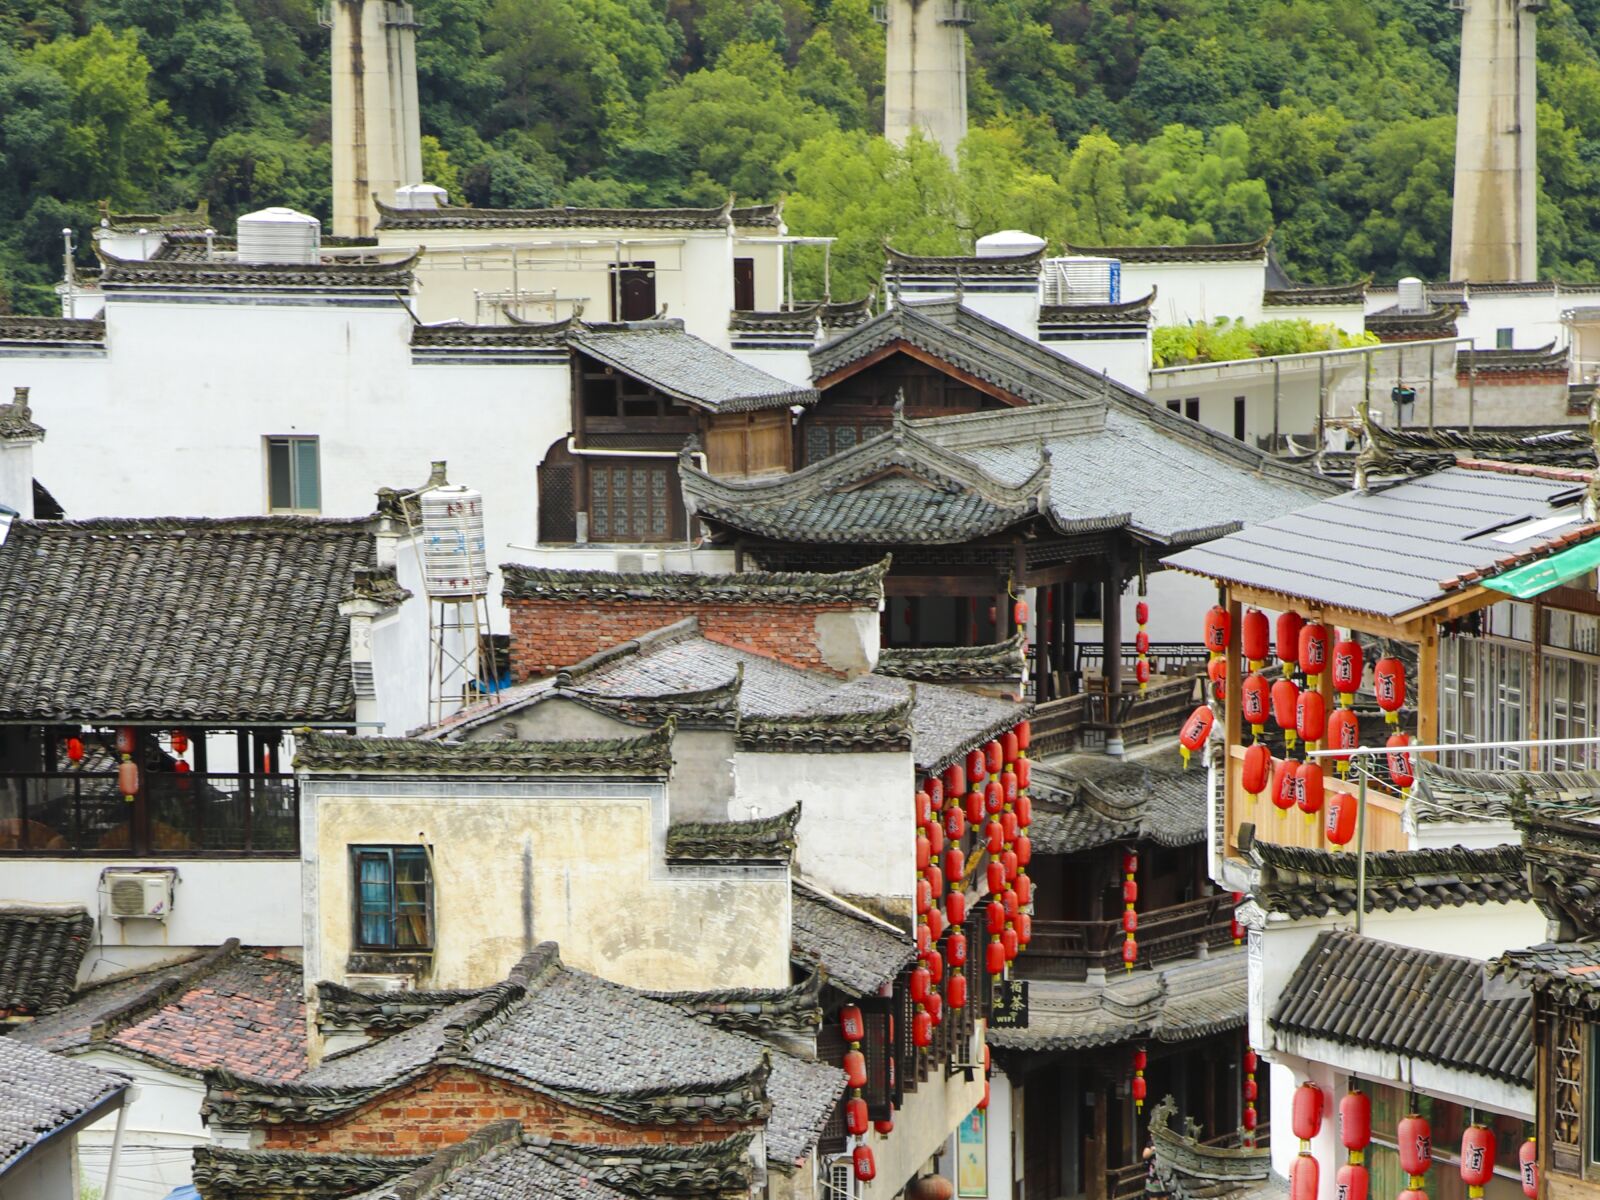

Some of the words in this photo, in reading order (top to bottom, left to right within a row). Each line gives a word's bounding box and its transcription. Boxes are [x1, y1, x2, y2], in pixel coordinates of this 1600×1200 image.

[1210, 626, 1224, 646] 酒
[1309, 638, 1324, 663] 酒
[1336, 654, 1353, 681] 酒
[1379, 673, 1395, 700] 酒
[1246, 690, 1260, 713] 酒
[1465, 1145, 1485, 1172] 酒
